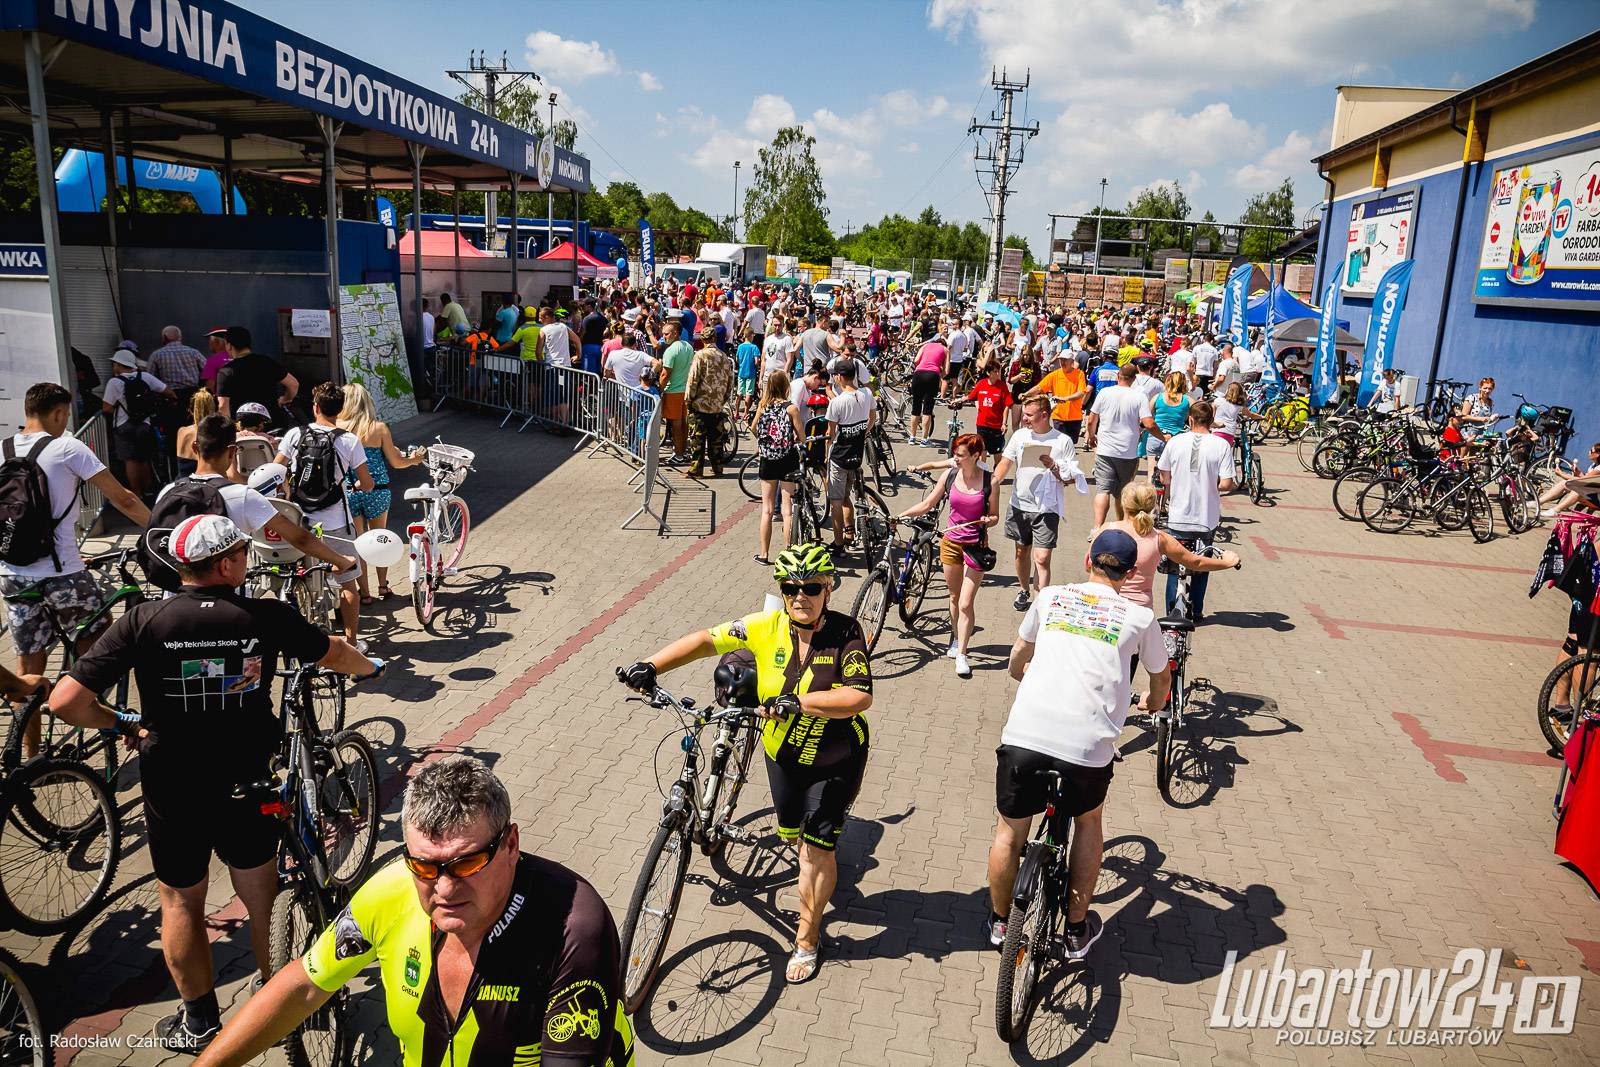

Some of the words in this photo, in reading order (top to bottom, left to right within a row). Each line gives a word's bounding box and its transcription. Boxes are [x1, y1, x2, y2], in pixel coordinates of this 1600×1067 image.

[275, 40, 459, 145] BEZDOTYKOWA
[470, 119, 499, 158] 24h
[162, 163, 200, 183] MAPEI
[558, 157, 584, 183] MRÓWKA
[1531, 209, 1547, 221] VIVA
[1556, 212, 1570, 229] TV
[1562, 236, 1600, 250] OGRODO
[1564, 252, 1578, 262] VIVA
[1371, 282, 1400, 385] DECATHLON
[209, 531, 239, 556] POLSKA
[164, 641, 184, 650] Vejle
[184, 640, 217, 648] Tekniske
[217, 639, 239, 647] Skole
[797, 737, 821, 766] GRUPA
[488, 893, 525, 944] POLAND
[401, 985, 419, 999] CHEŁM
[476, 985, 520, 1002] JANUSZ
